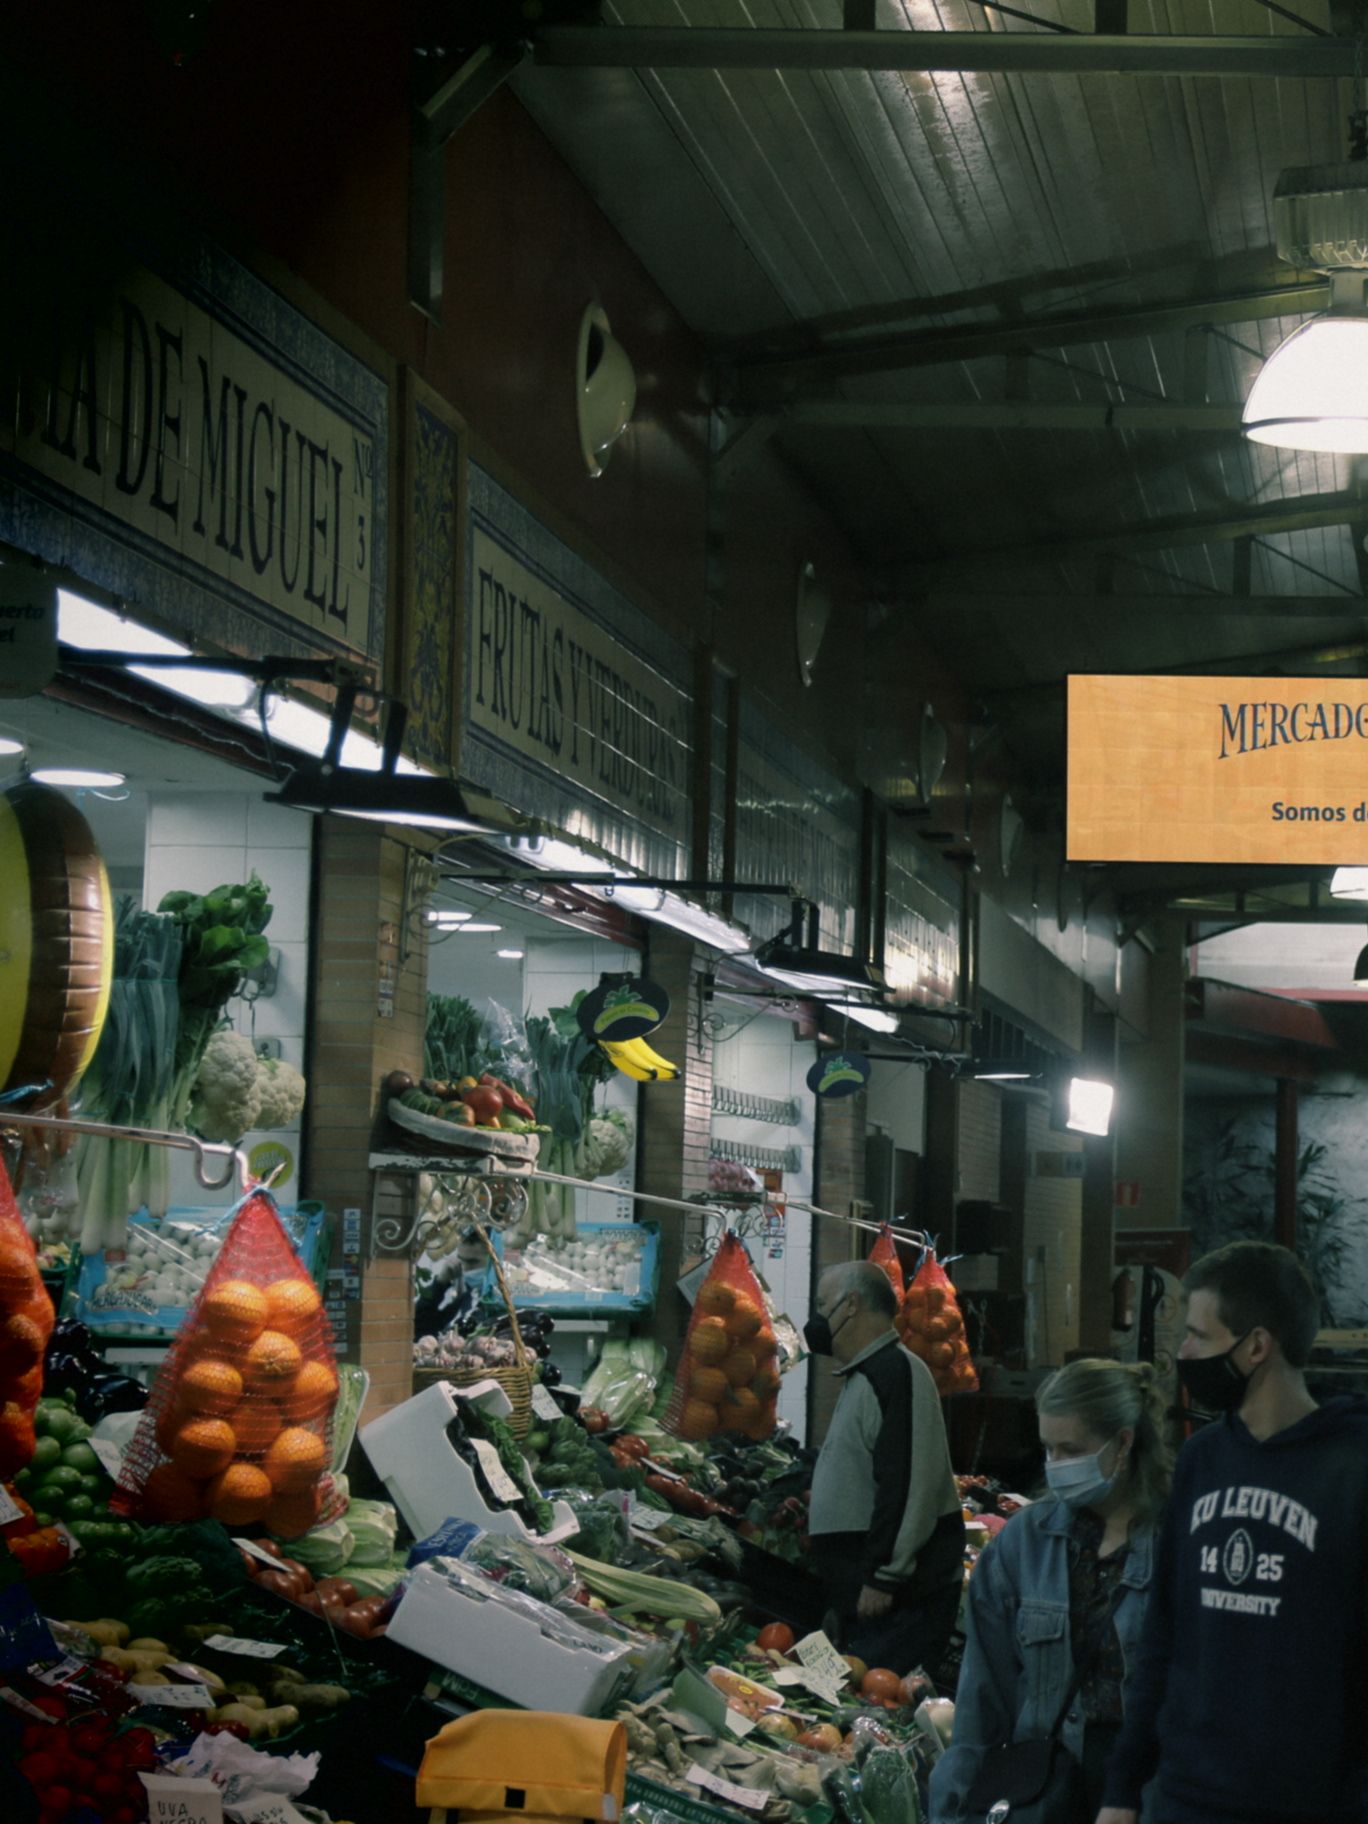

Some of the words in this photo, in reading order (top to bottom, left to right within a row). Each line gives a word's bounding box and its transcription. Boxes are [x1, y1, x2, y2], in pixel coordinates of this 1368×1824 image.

[116, 294, 183, 535] DE
[193, 354, 350, 637] MIGUEL
[356, 515, 365, 570] 3
[475, 566, 564, 756] FRUTAS
[568, 639, 584, 767] Y
[1271, 801, 1346, 822] Somos
[1221, 1486, 1319, 1552] LEUVEN
[1200, 1545, 1219, 1574] 14
[1255, 1553, 1285, 1582] 25
[157, 1801, 189, 1817] UVA
